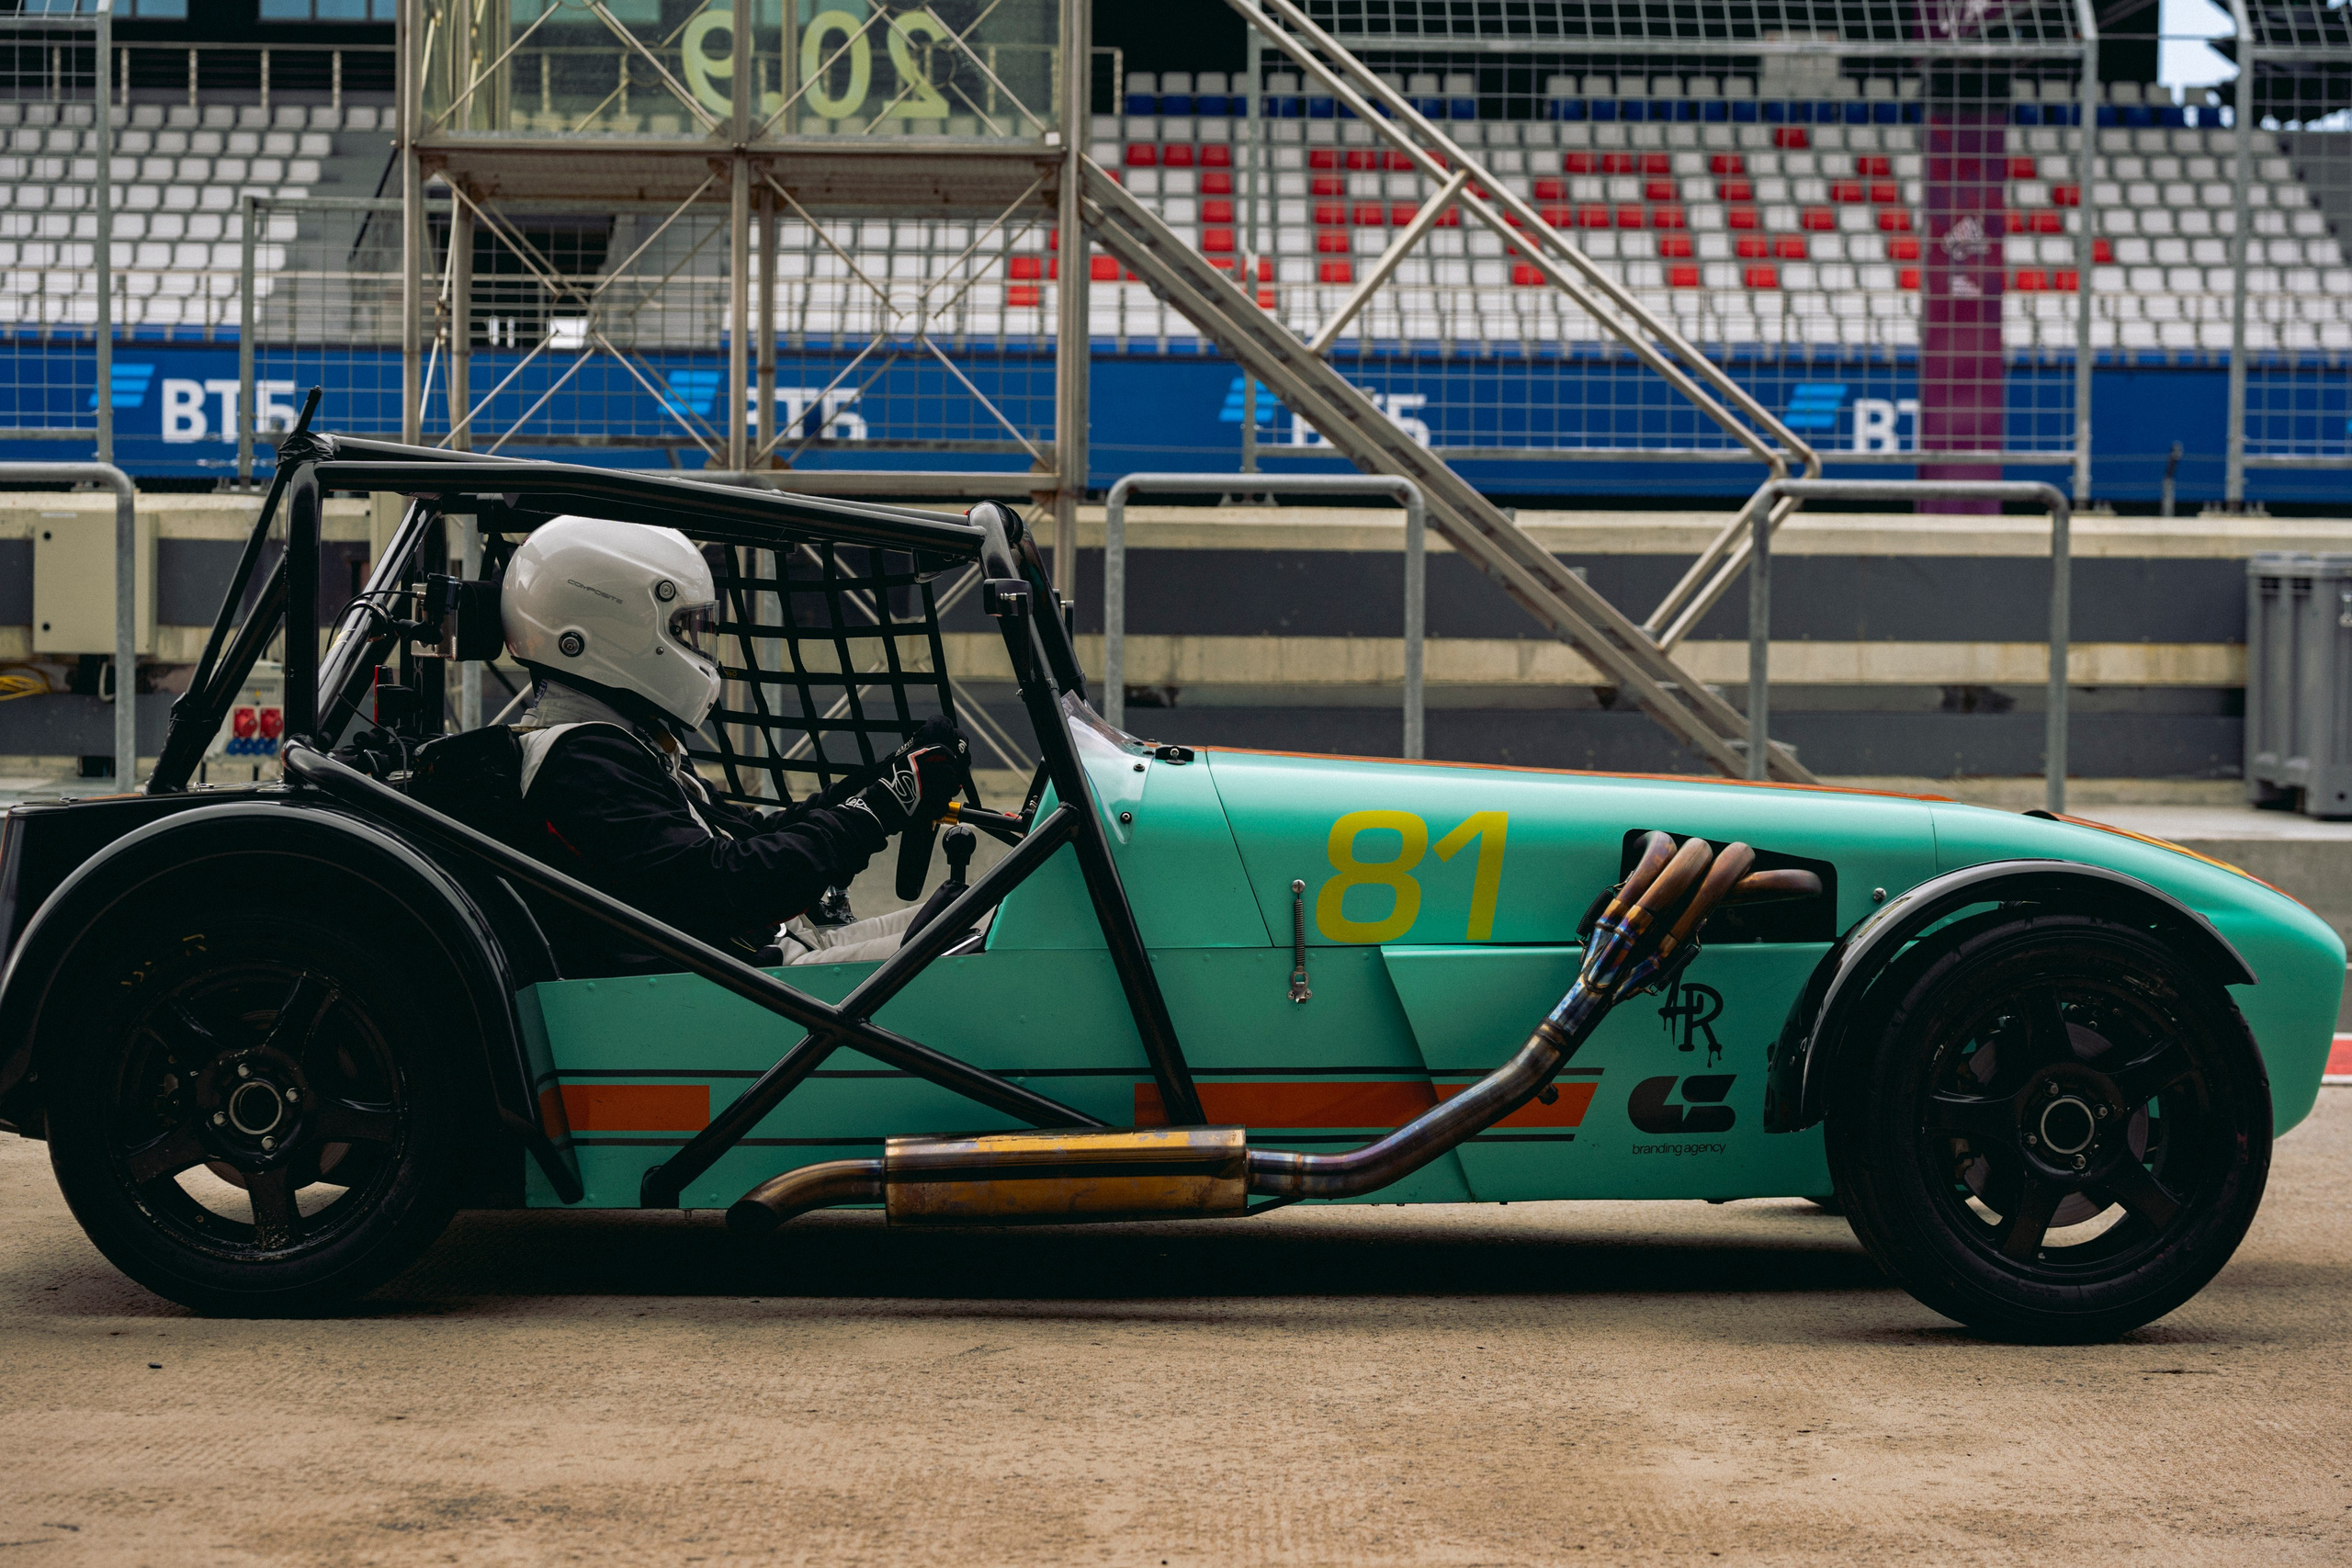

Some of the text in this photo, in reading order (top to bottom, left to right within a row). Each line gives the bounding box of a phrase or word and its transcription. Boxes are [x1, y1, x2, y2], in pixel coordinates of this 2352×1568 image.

[162, 378, 300, 444] ВТБ
[744, 387, 868, 441] ТБ
[567, 579, 624, 604] COMPOSITE
[1316, 809, 1509, 943] 81
[1632, 1143, 1726, 1156] branding agency
